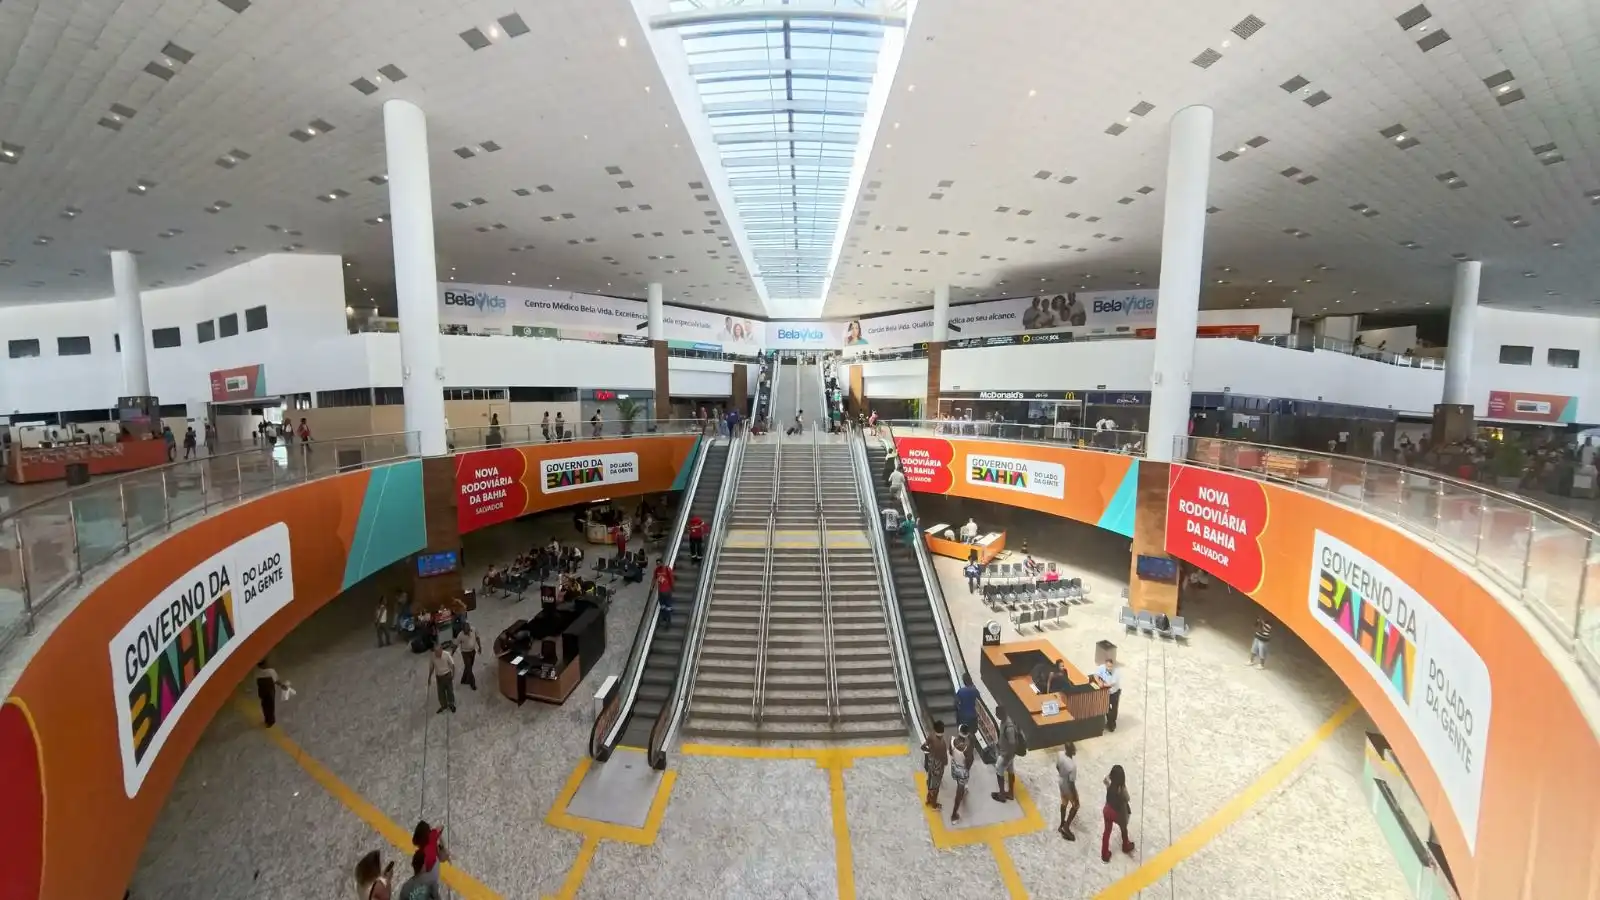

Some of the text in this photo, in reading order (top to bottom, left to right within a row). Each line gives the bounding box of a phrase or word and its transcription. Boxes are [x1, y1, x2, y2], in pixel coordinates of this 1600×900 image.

[444, 291, 506, 312] BelaVida
[524, 300, 551, 309] Centro
[552, 301, 579, 311] Médico
[580, 304, 596, 314] Bela
[1093, 296, 1154, 313] BelaVida
[989, 313, 1017, 321] alcance.
[778, 327, 823, 341] BelaVida
[980, 391, 1024, 399] McDonald's
[901, 455, 942, 467] ODOVIÁRIA
[909, 449, 930, 458] NOVA
[972, 458, 1013, 469] GOVERNO
[475, 467, 499, 479] NOVA
[546, 459, 603, 472] GOVERNO DA
[913, 466, 936, 475] BAHIA
[461, 475, 513, 494] RODOVIÁRIA
[547, 467, 603, 489] BAHIA
[972, 466, 1027, 488] BAHIA
[1044, 479, 1059, 487] GENTE
[469, 489, 507, 505] DA BAHIA
[1198, 486, 1230, 508] NOVA
[475, 502, 504, 515] SALVADOR
[1179, 499, 1247, 535] RODOVIÁRIA
[1186, 520, 1236, 552] DA BAHIA
[1192, 541, 1229, 567] SALVADOR
[242, 552, 281, 586] DO LADO
[244, 568, 284, 604] DA GENTE
[1321, 546, 1418, 642] GOVERNO DA
[125, 565, 230, 685] GOVERNO DA
[1317, 568, 1417, 706] BAHIA
[128, 590, 235, 767] BAHIA
[1429, 658, 1474, 737] DO LADO
[1426, 684, 1472, 774] DA GENTE
